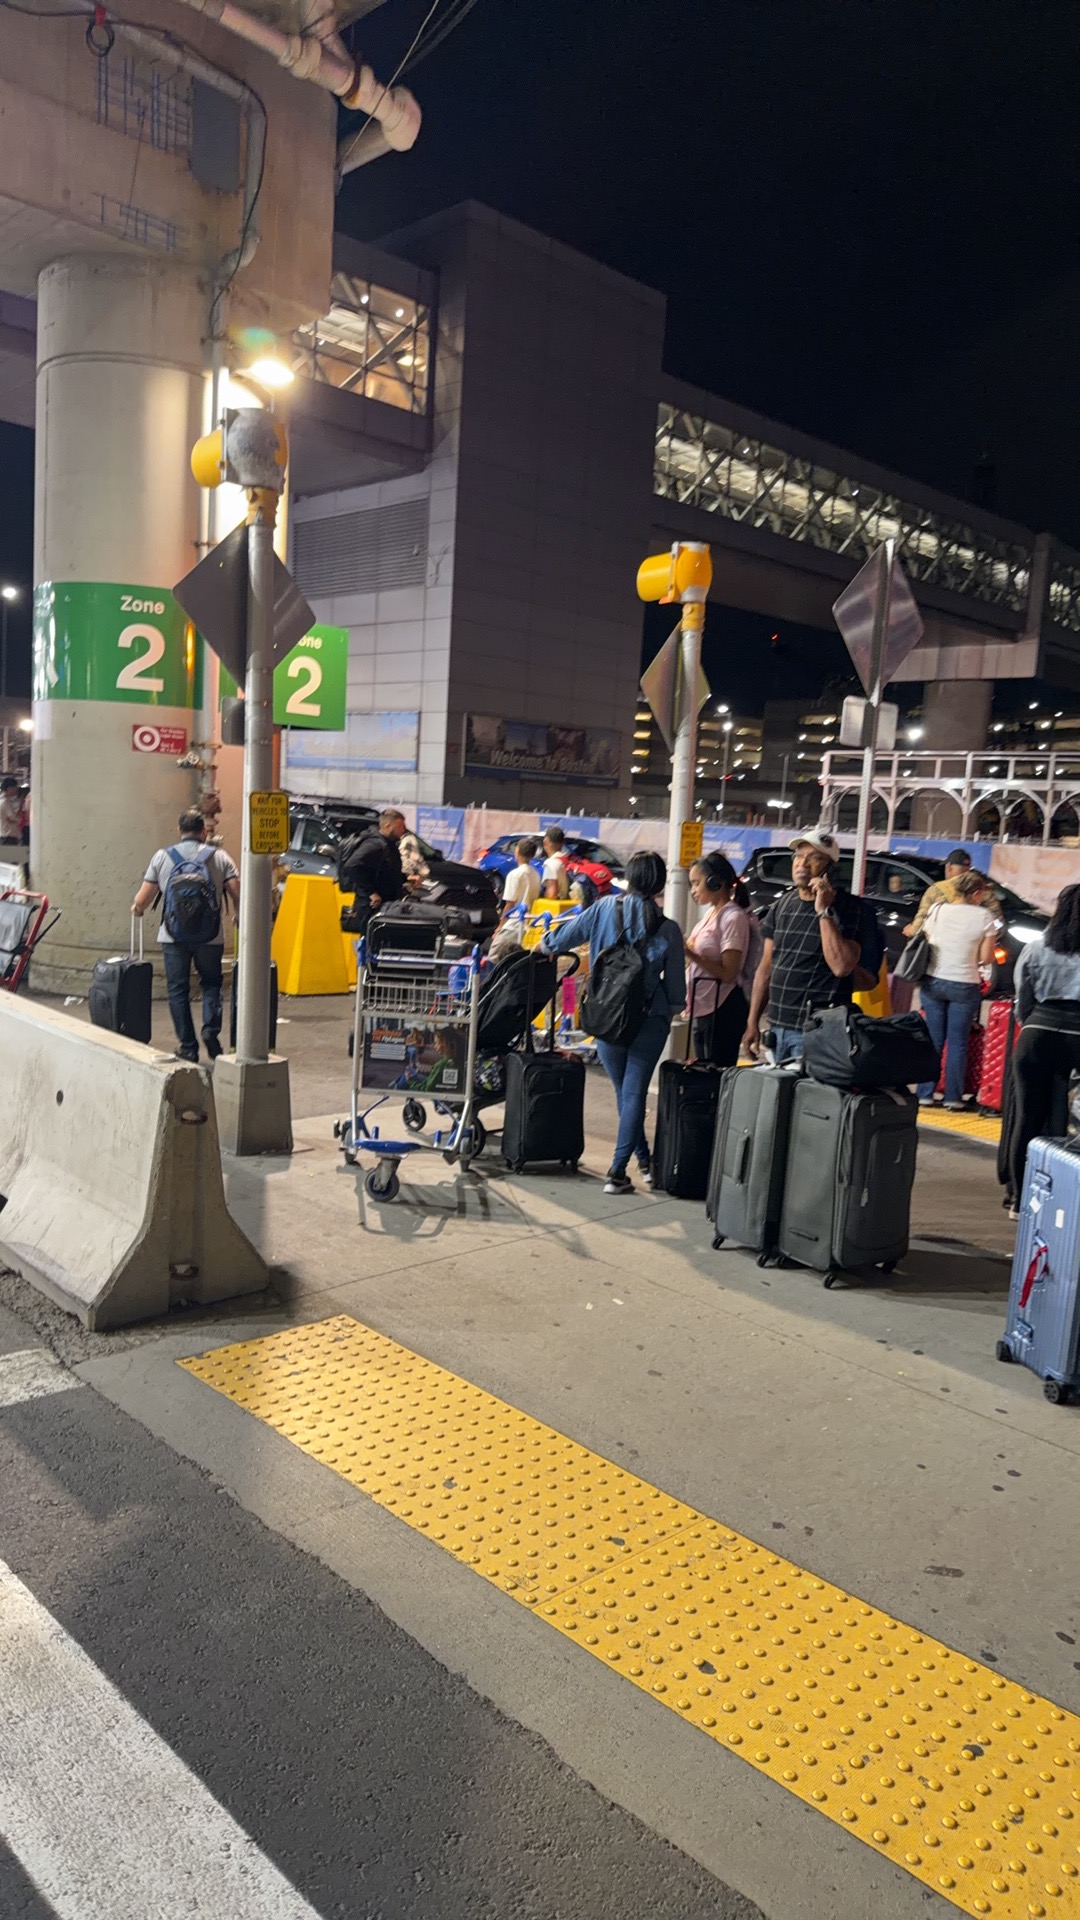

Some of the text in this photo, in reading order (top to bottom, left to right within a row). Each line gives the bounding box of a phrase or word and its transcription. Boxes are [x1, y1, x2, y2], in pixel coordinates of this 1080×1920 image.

[120, 595, 165, 615] Zone
[298, 635, 322, 649] one
[116, 623, 165, 692] 2
[285, 655, 322, 717] 2
[490, 749, 543, 769] Welcome
[259, 818, 280, 828] STOP
